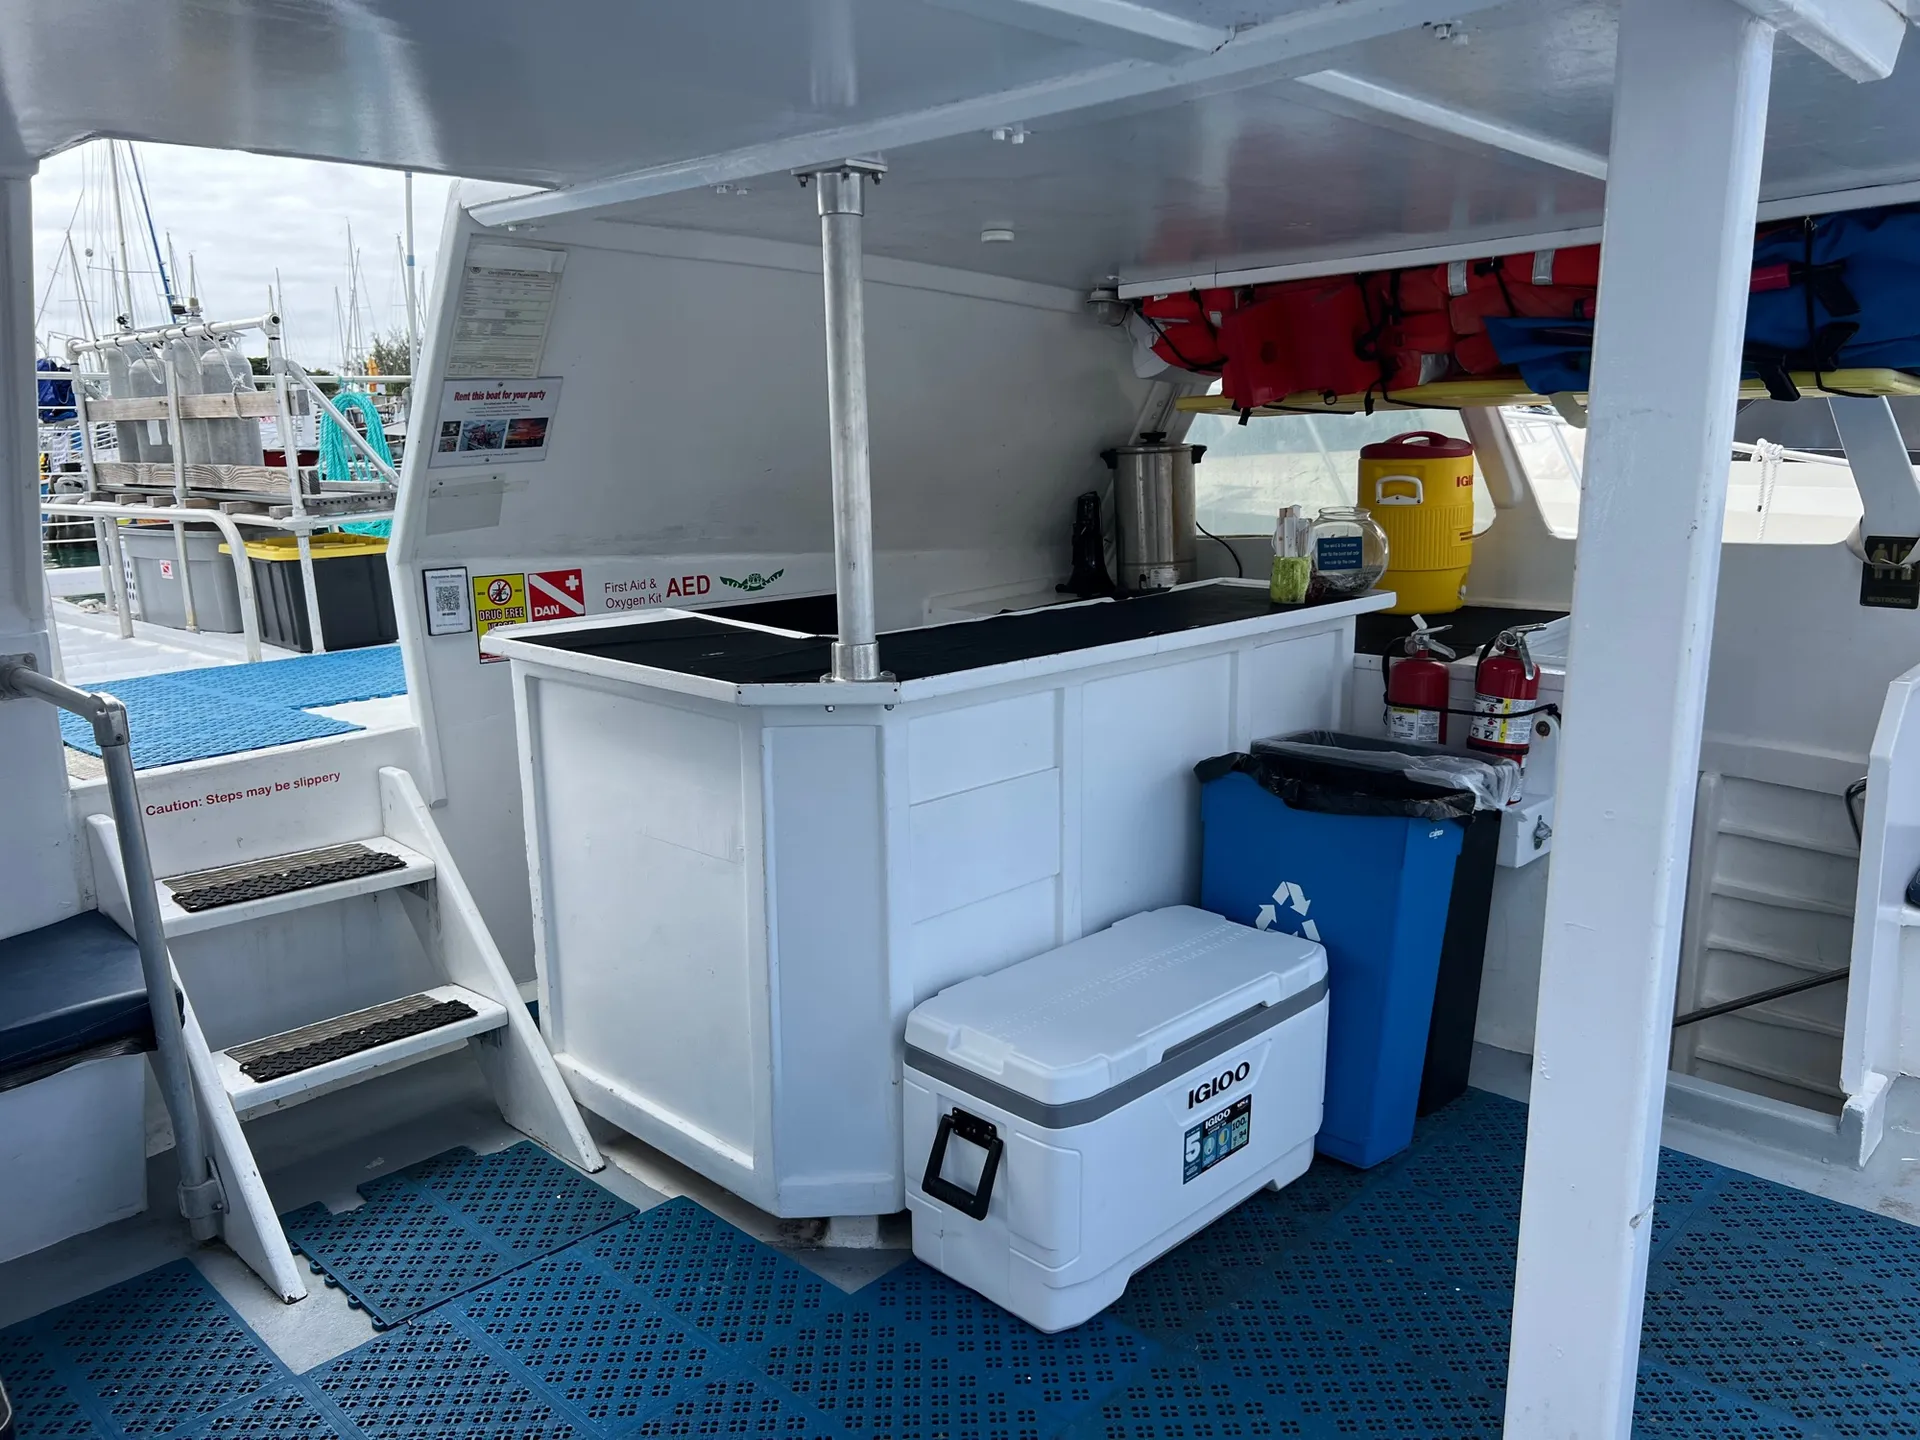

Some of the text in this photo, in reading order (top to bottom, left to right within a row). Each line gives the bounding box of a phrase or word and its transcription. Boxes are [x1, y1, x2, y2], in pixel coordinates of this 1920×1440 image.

[454, 390, 546, 401] Rent this boat for your party
[604, 578, 657, 594] First Aid &
[666, 574, 710, 598] AED
[534, 605, 560, 617] DAN
[606, 593, 662, 610] Oxygen Kit
[479, 607, 524, 621] DRUG FREE
[146, 771, 341, 816] Caution: Steps may be slippery
[1188, 1061, 1250, 1110] IGLOO
[1205, 1108, 1231, 1130] IGLOO
[1185, 1130, 1201, 1163] 5
